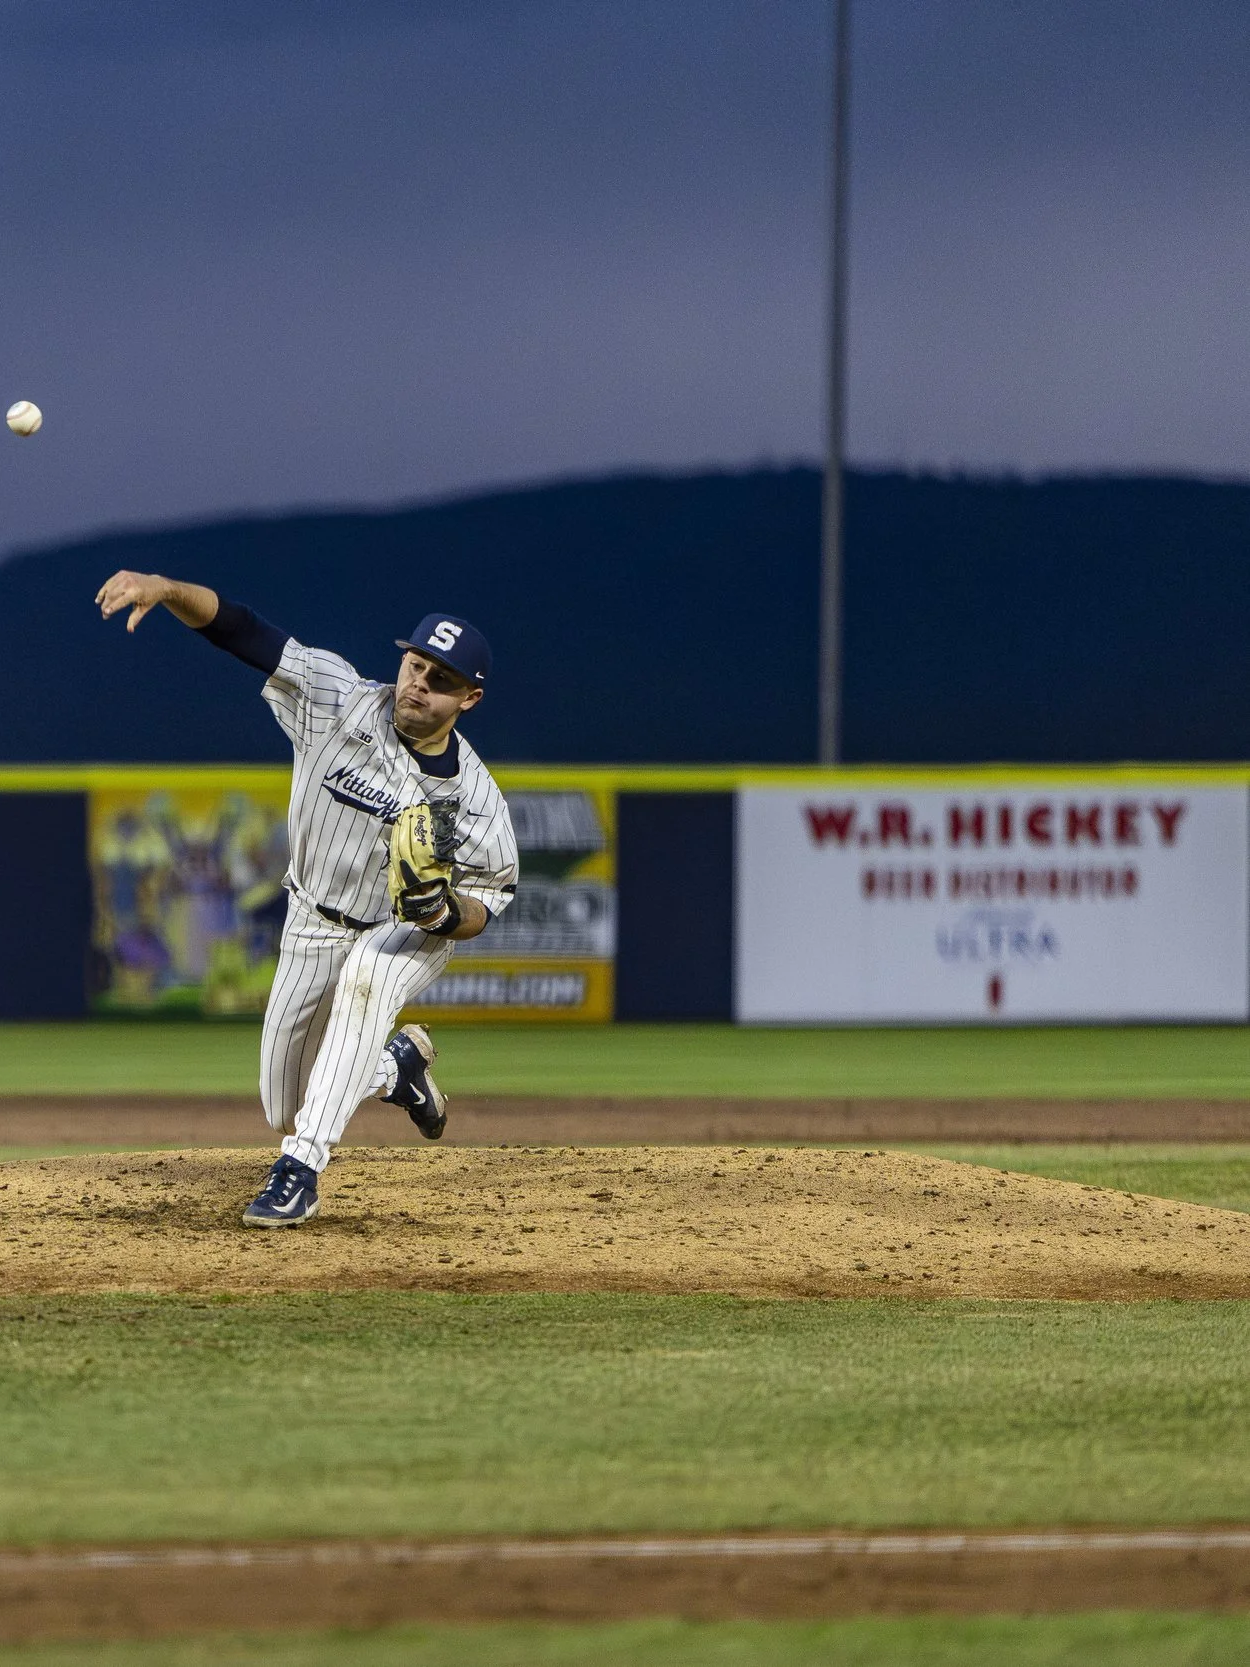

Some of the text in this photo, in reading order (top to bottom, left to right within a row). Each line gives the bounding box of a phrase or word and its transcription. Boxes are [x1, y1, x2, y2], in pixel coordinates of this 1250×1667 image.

[426, 621, 463, 652] S
[324, 766, 401, 818] Nittany
[803, 801, 1188, 848] W.R. HICKEY
